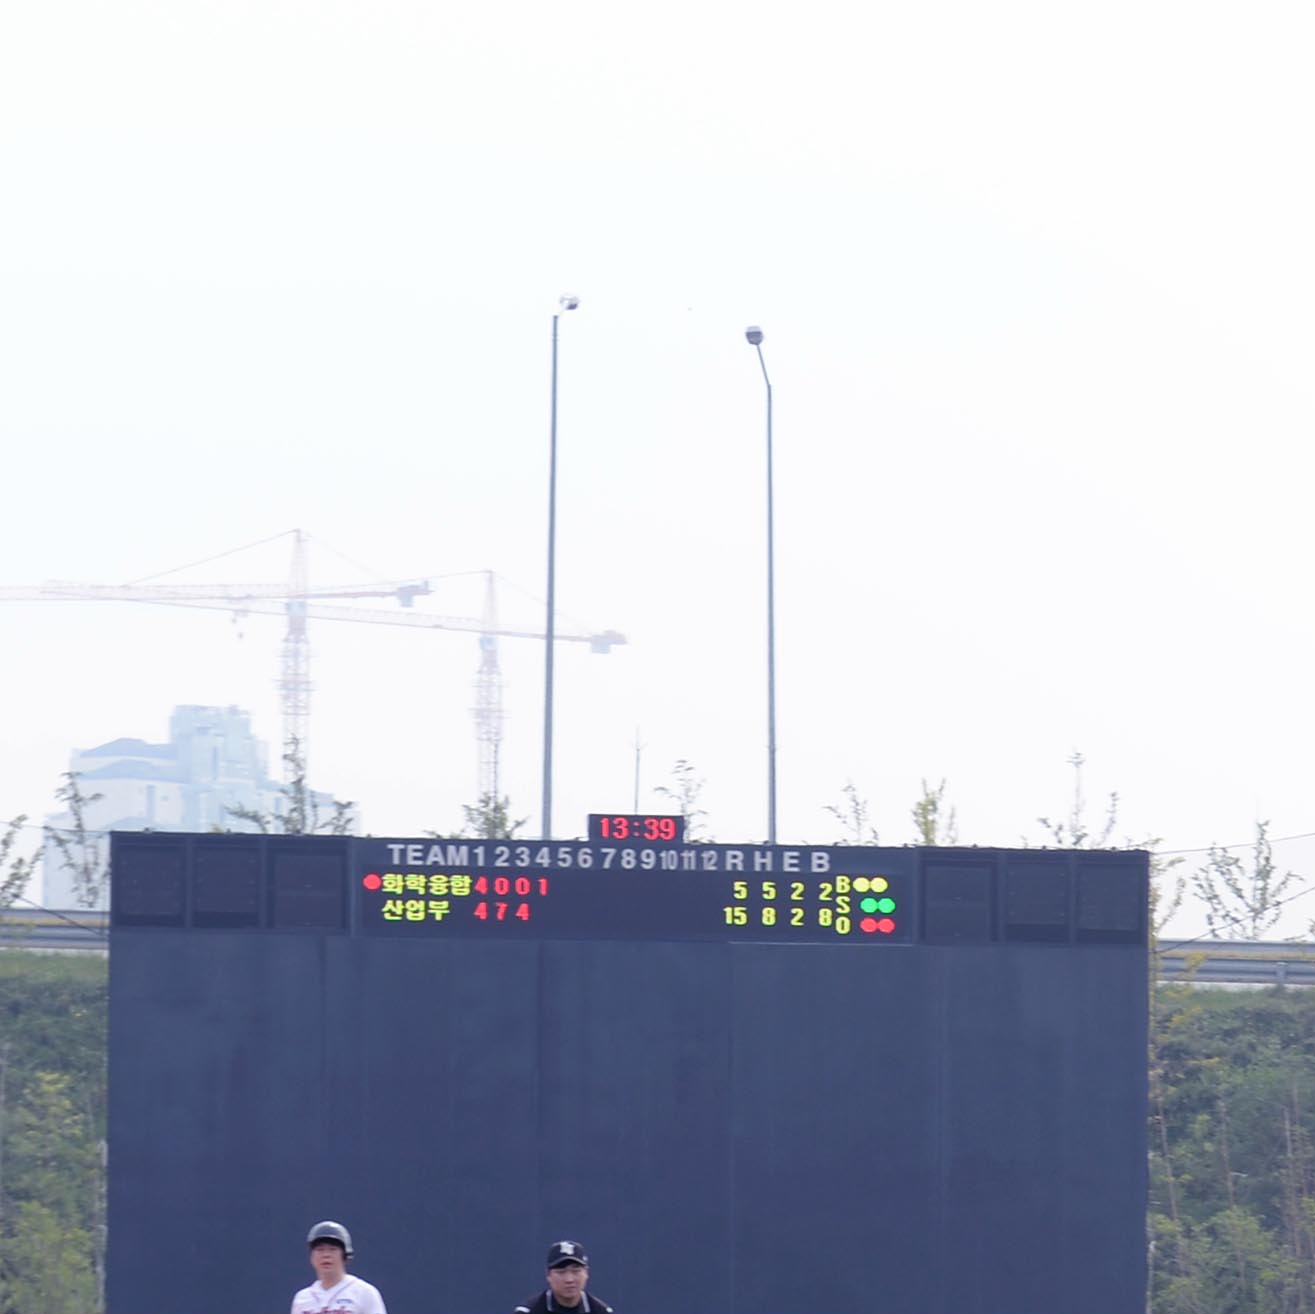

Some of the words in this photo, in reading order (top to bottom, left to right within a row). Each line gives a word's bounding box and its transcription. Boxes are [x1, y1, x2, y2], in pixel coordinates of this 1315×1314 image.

[600, 817, 676, 840] 13:39
[387, 844, 469, 866] TEAM
[473, 846, 486, 866] 1
[495, 846, 510, 867] 2
[515, 847, 530, 867] 3
[535, 847, 551, 867] 4
[557, 847, 573, 868] 5
[577, 848, 593, 868] 6
[600, 848, 617, 869] 7
[621, 848, 636, 869] 8
[640, 848, 656, 870] 9
[660, 850, 678, 870] 10
[681, 850, 696, 870] 11
[701, 850, 718, 871] 12
[725, 850, 744, 871] R
[754, 851, 772, 872] H
[783, 851, 801, 872] E
[811, 852, 831, 873] B
[382, 873, 472, 896] 화학융합
[474, 876, 488, 895] 4
[494, 876, 510, 895] 0
[515, 877, 530, 896] 0
[537, 877, 549, 896] 1
[733, 881, 748, 899] 5
[762, 881, 776, 900] 5
[790, 882, 805, 900] 2
[819, 882, 833, 901] 2
[835, 875, 850, 893] B
[382, 900, 450, 921] 산업부
[474, 902, 488, 920] 4
[495, 902, 508, 920] 7
[515, 903, 530, 921] 4
[723, 907, 748, 925] 15
[762, 907, 776, 926] 8
[790, 908, 804, 926] 2
[819, 908, 833, 926] 8
[835, 896, 850, 914] S
